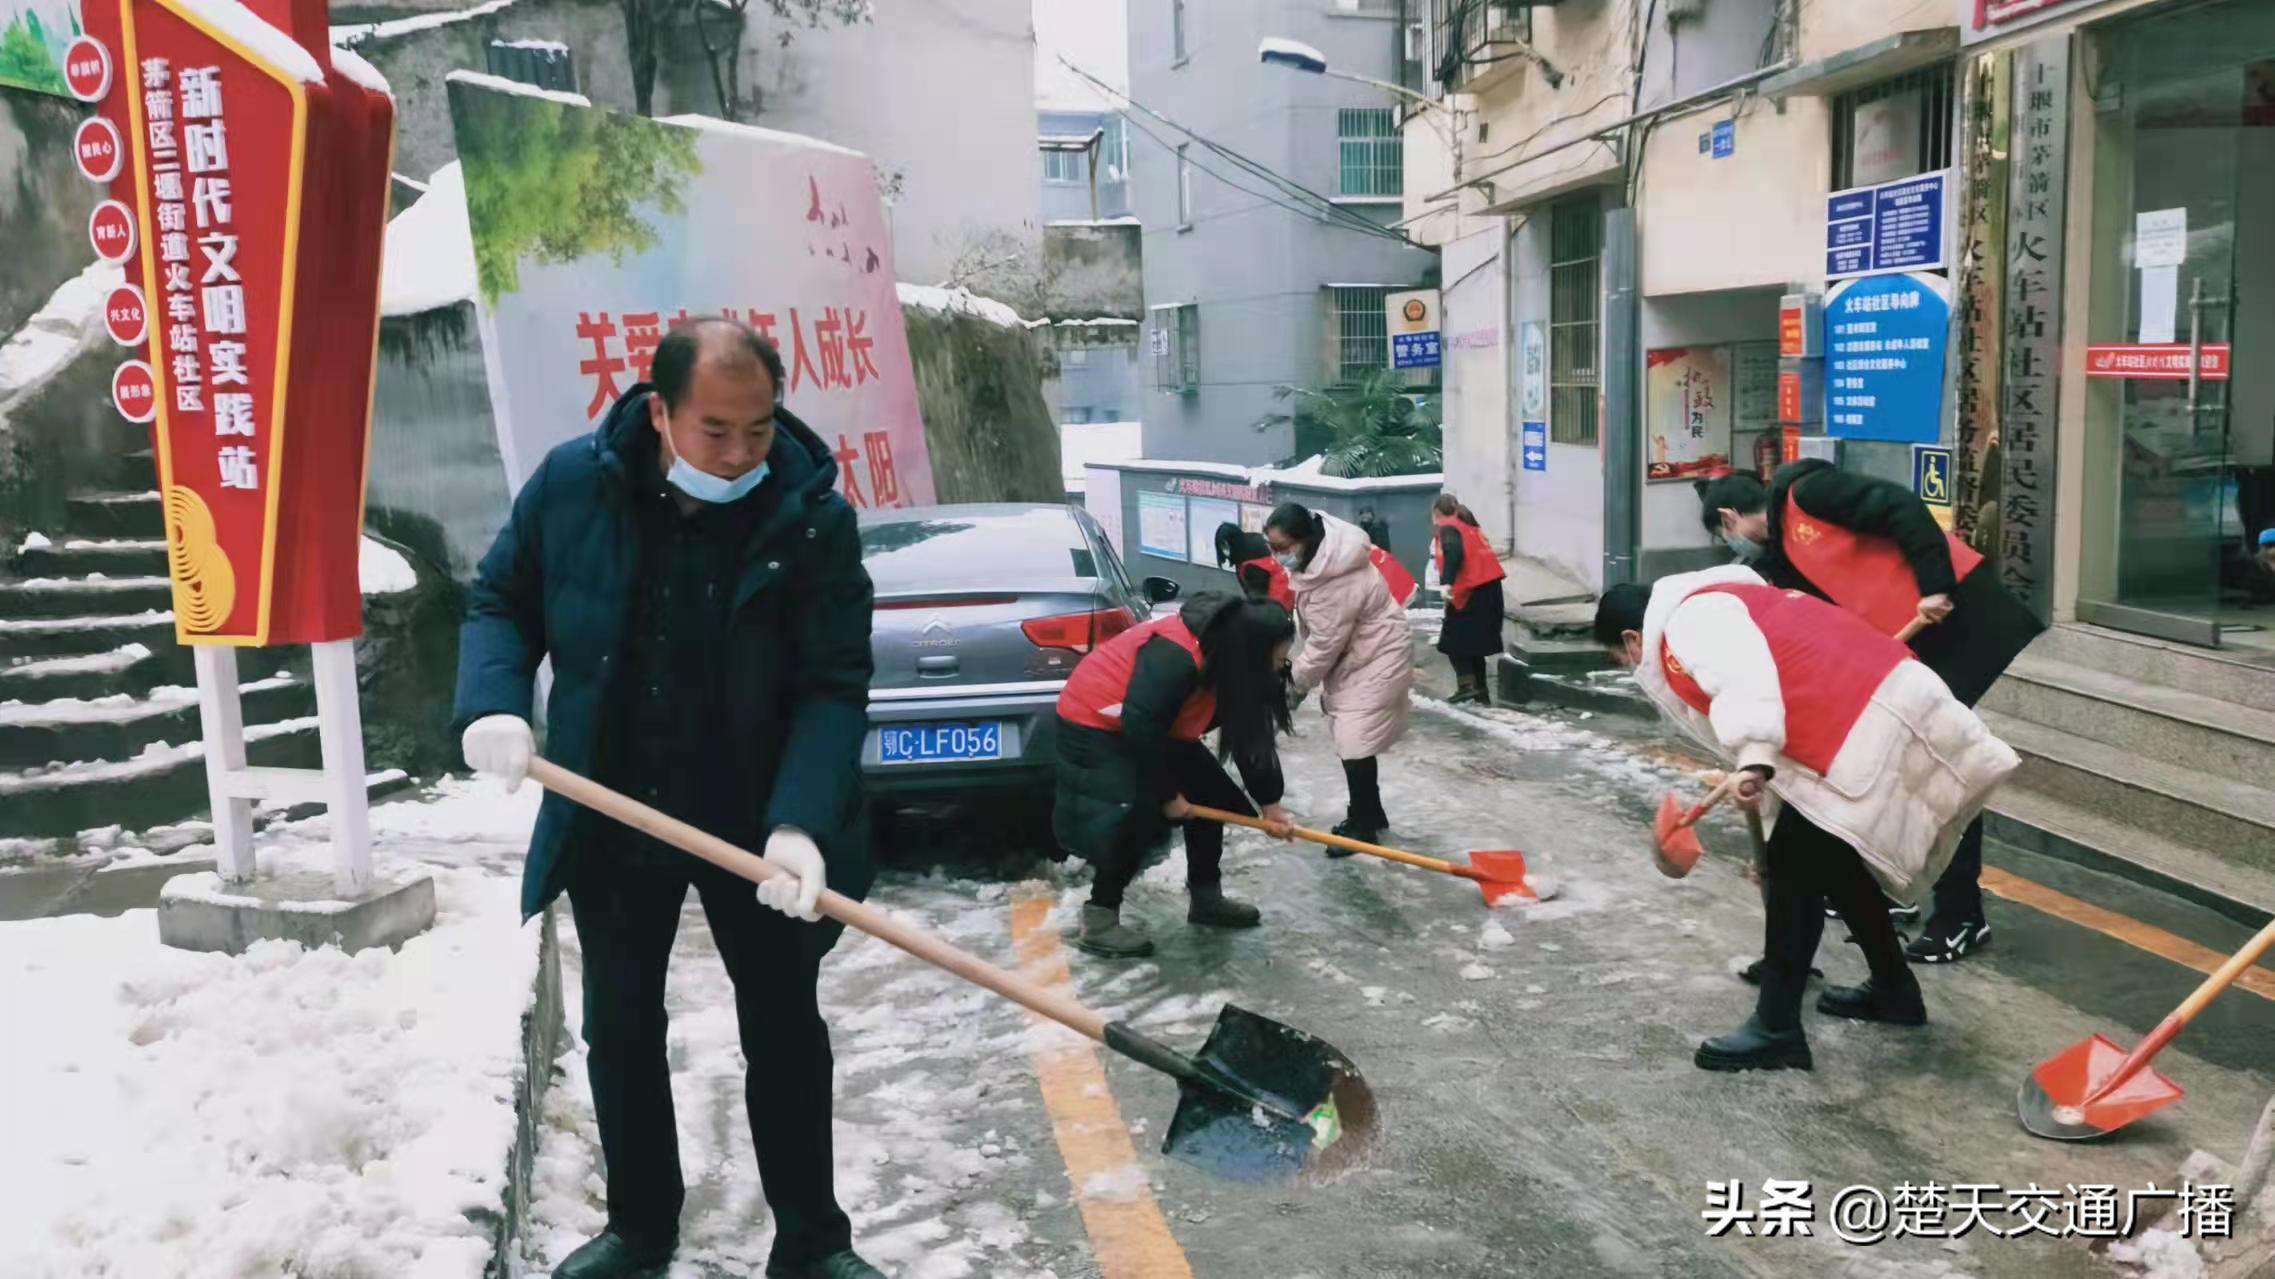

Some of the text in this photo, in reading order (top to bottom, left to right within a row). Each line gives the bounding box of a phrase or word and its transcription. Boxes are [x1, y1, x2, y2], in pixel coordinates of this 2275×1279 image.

[110, 308, 142, 323] 兴文化
[142, 57, 203, 412] 茅箭区二堰街道火车站社区
[180, 66, 259, 489] 新时代文明实践站
